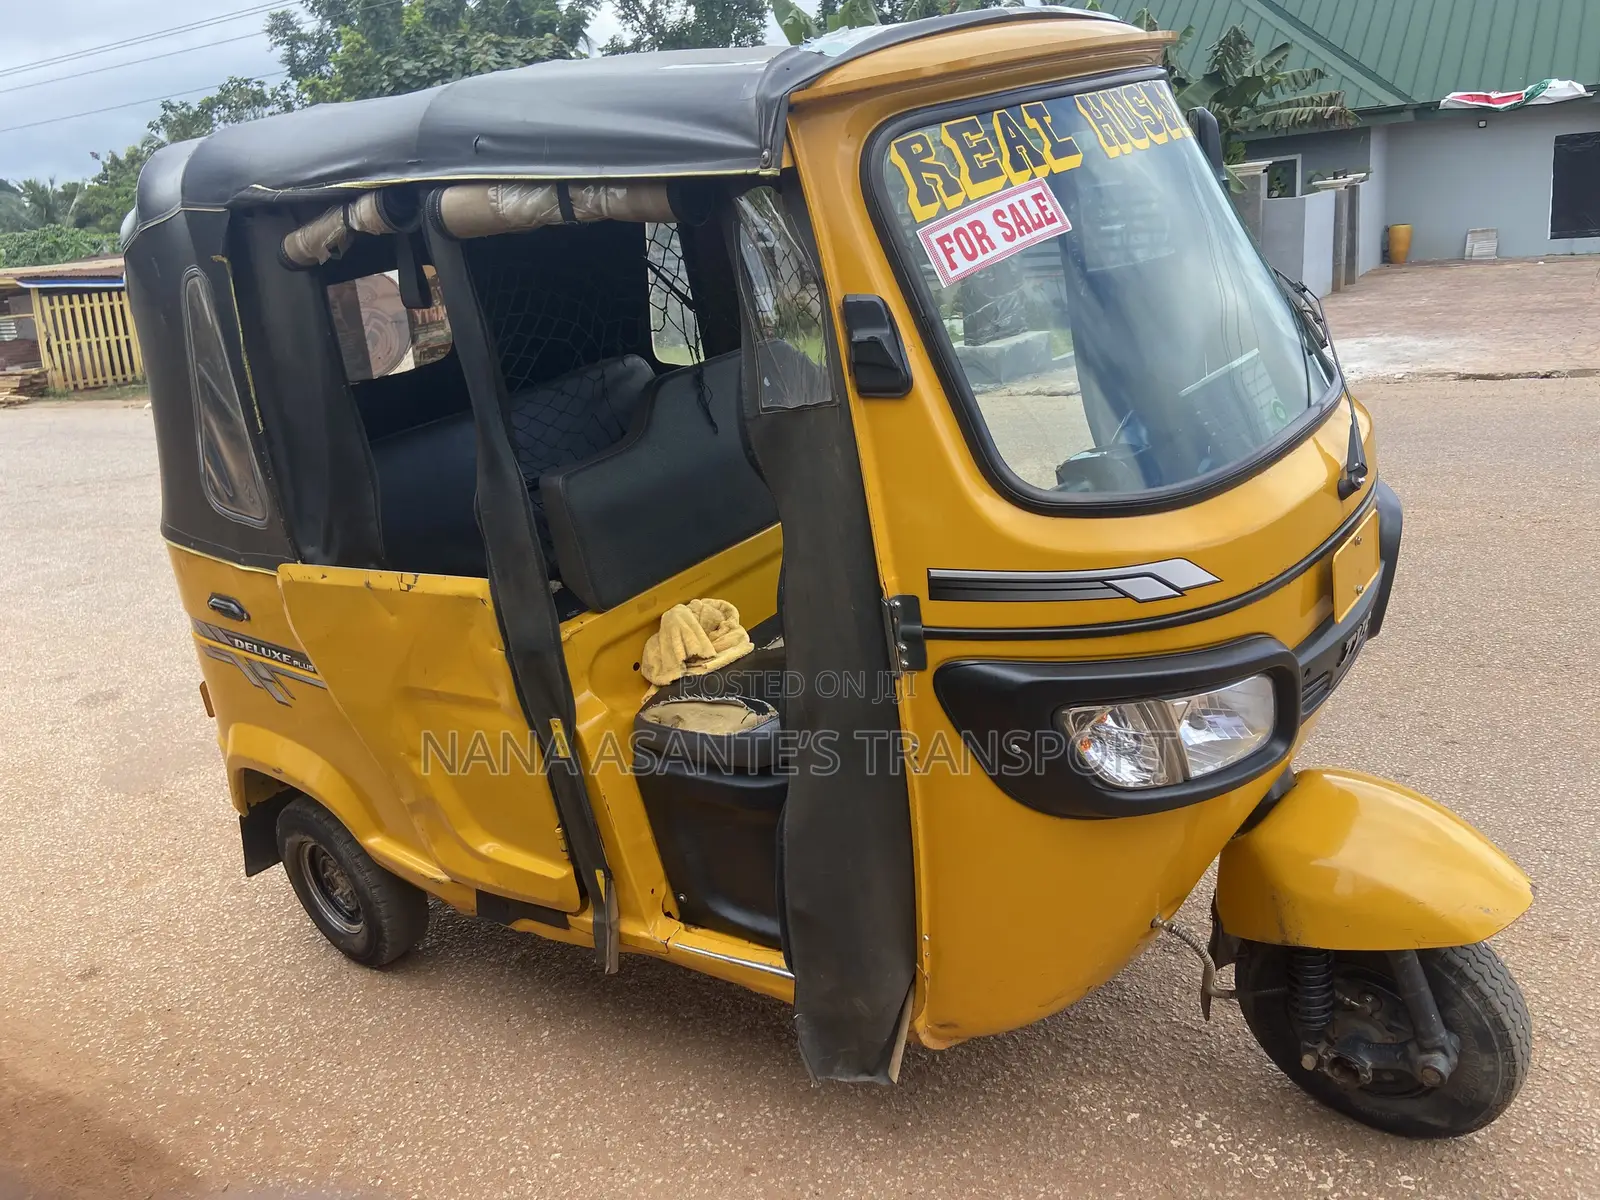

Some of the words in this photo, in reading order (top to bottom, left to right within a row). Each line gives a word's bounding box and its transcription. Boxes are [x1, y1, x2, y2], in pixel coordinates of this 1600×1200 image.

[890, 101, 1083, 222] REAL
[935, 219, 997, 271] FOR
[992, 191, 1059, 243] SALE
[234, 638, 292, 665] DELUXE
[292, 660, 315, 672] PLUS
